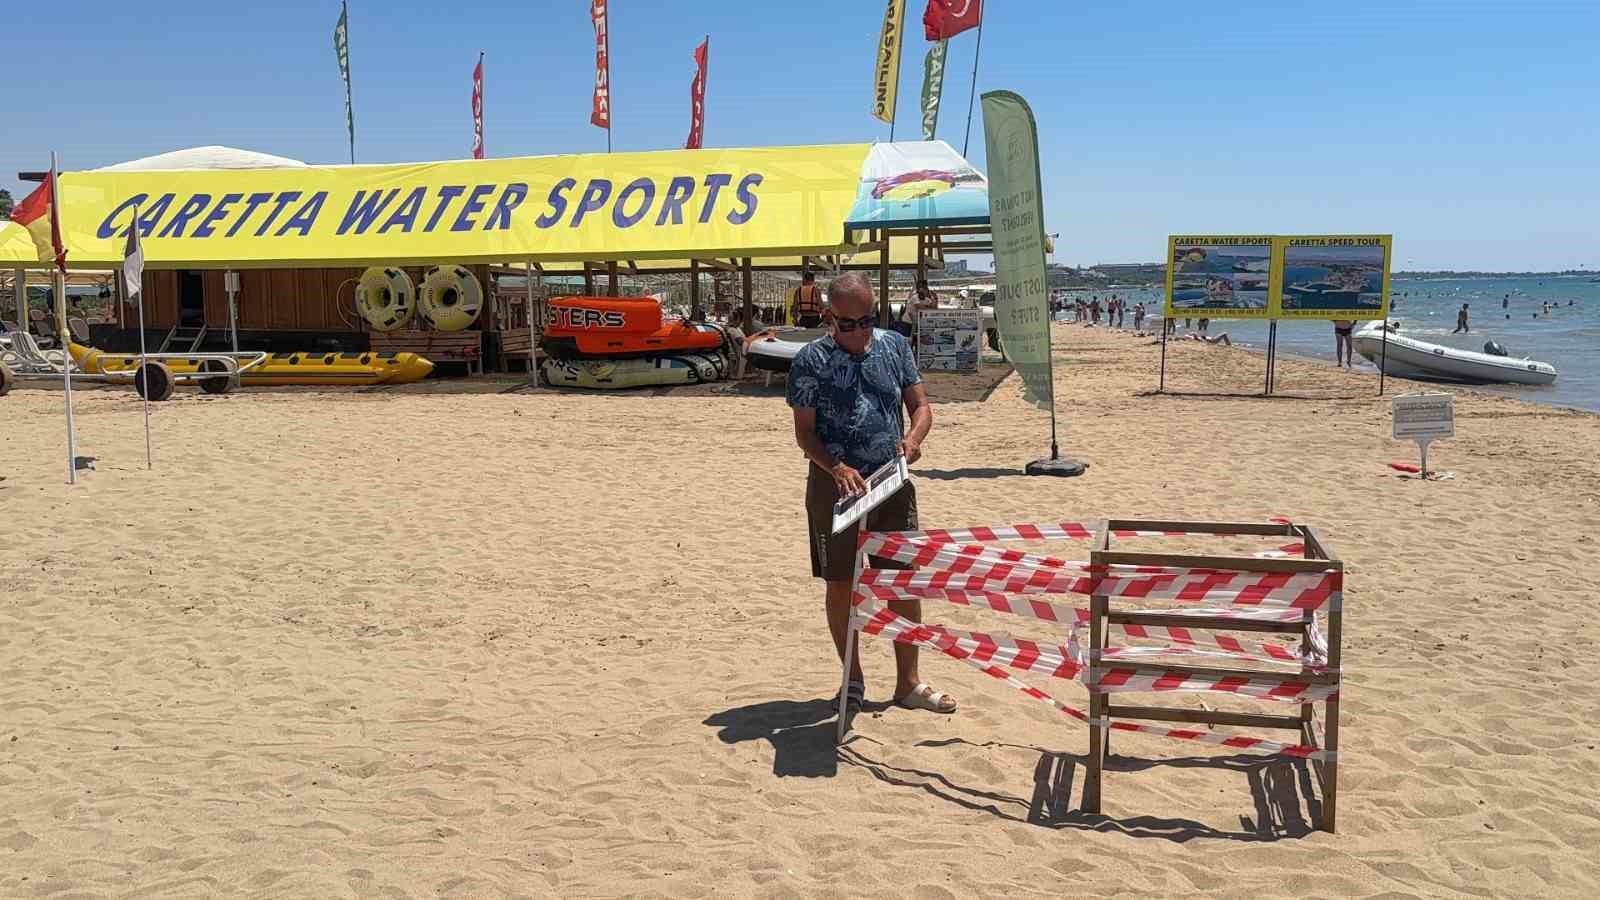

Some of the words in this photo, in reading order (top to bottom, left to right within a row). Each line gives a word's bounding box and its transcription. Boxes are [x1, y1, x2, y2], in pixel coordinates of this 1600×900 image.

[593, 6, 606, 57] JET
[877, 0, 895, 115] RASAILING
[923, 44, 943, 139] BANANA
[96, 191, 329, 240] CARETTA
[335, 182, 529, 236] WATER
[534, 172, 764, 229] SPORTS
[1174, 237, 1209, 246] CARETTA
[1212, 237, 1239, 246] WATER
[1241, 237, 1273, 246] SPORTS
[1289, 238, 1326, 247] CARETTA
[1328, 238, 1354, 247] SPEED
[1358, 237, 1382, 247] TOUR
[546, 304, 625, 329] STERS
